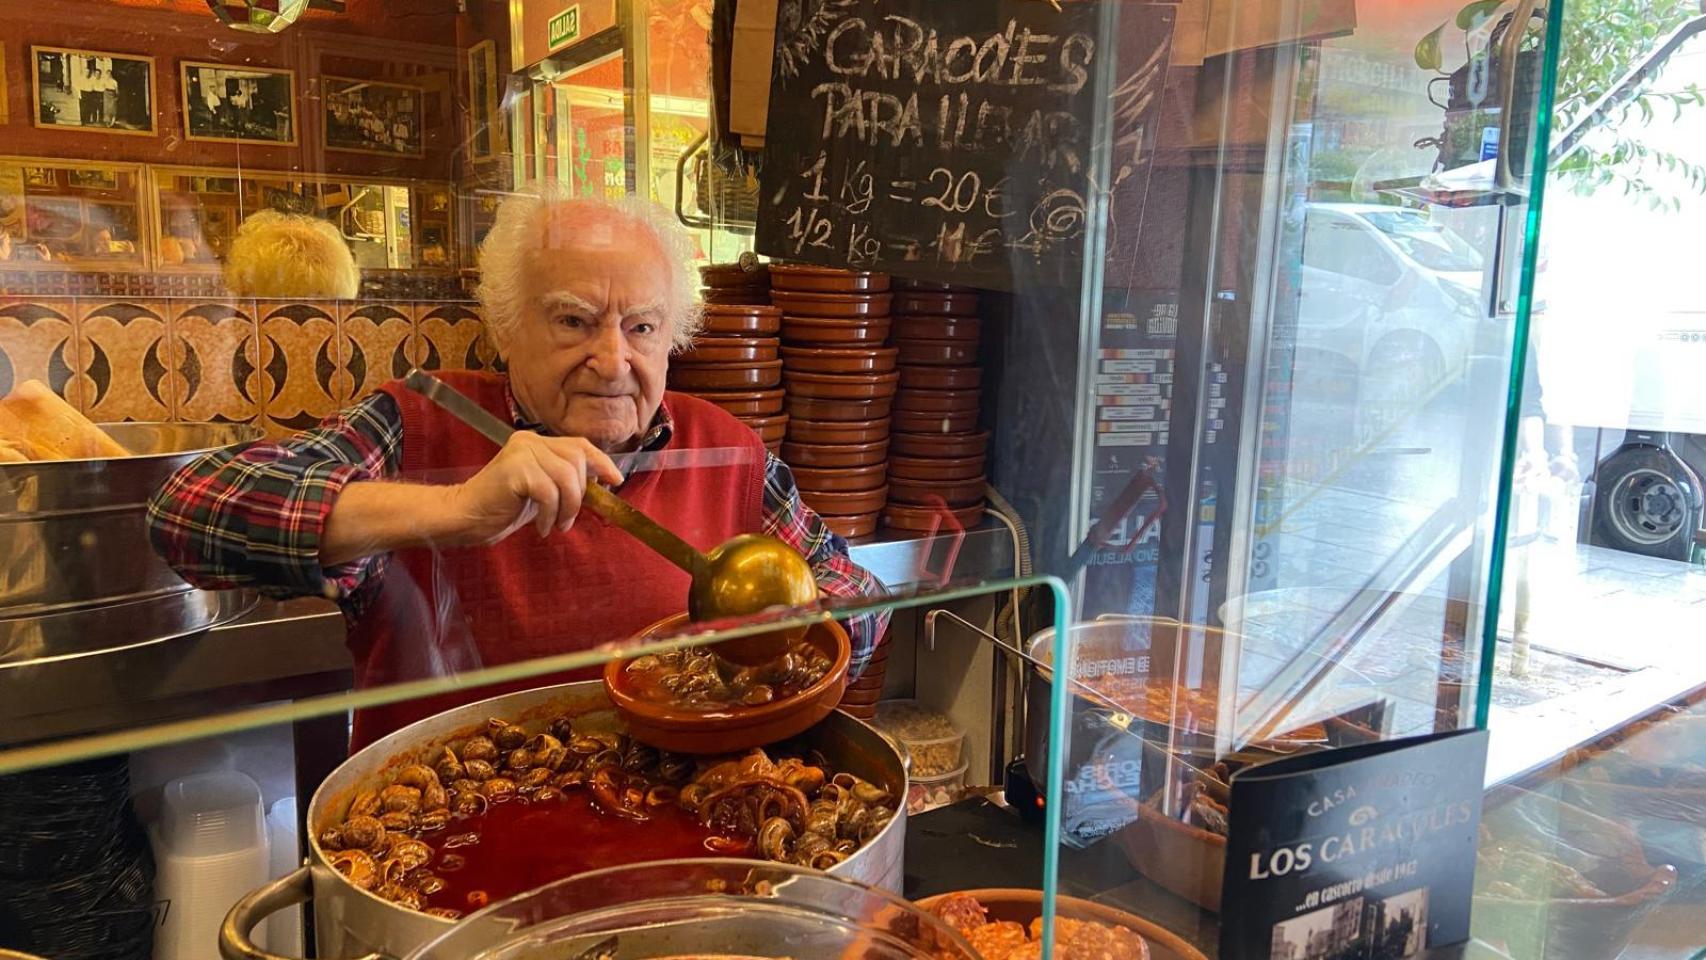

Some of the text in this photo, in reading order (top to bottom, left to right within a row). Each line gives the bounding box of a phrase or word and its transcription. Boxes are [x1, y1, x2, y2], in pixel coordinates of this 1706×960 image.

[811, 82, 923, 147] PARA
[800, 149, 830, 202] 1
[786, 206, 835, 255] 1/2
[1307, 785, 1357, 817] CASA
[1249, 799, 1473, 880] LOS CARACOLES
